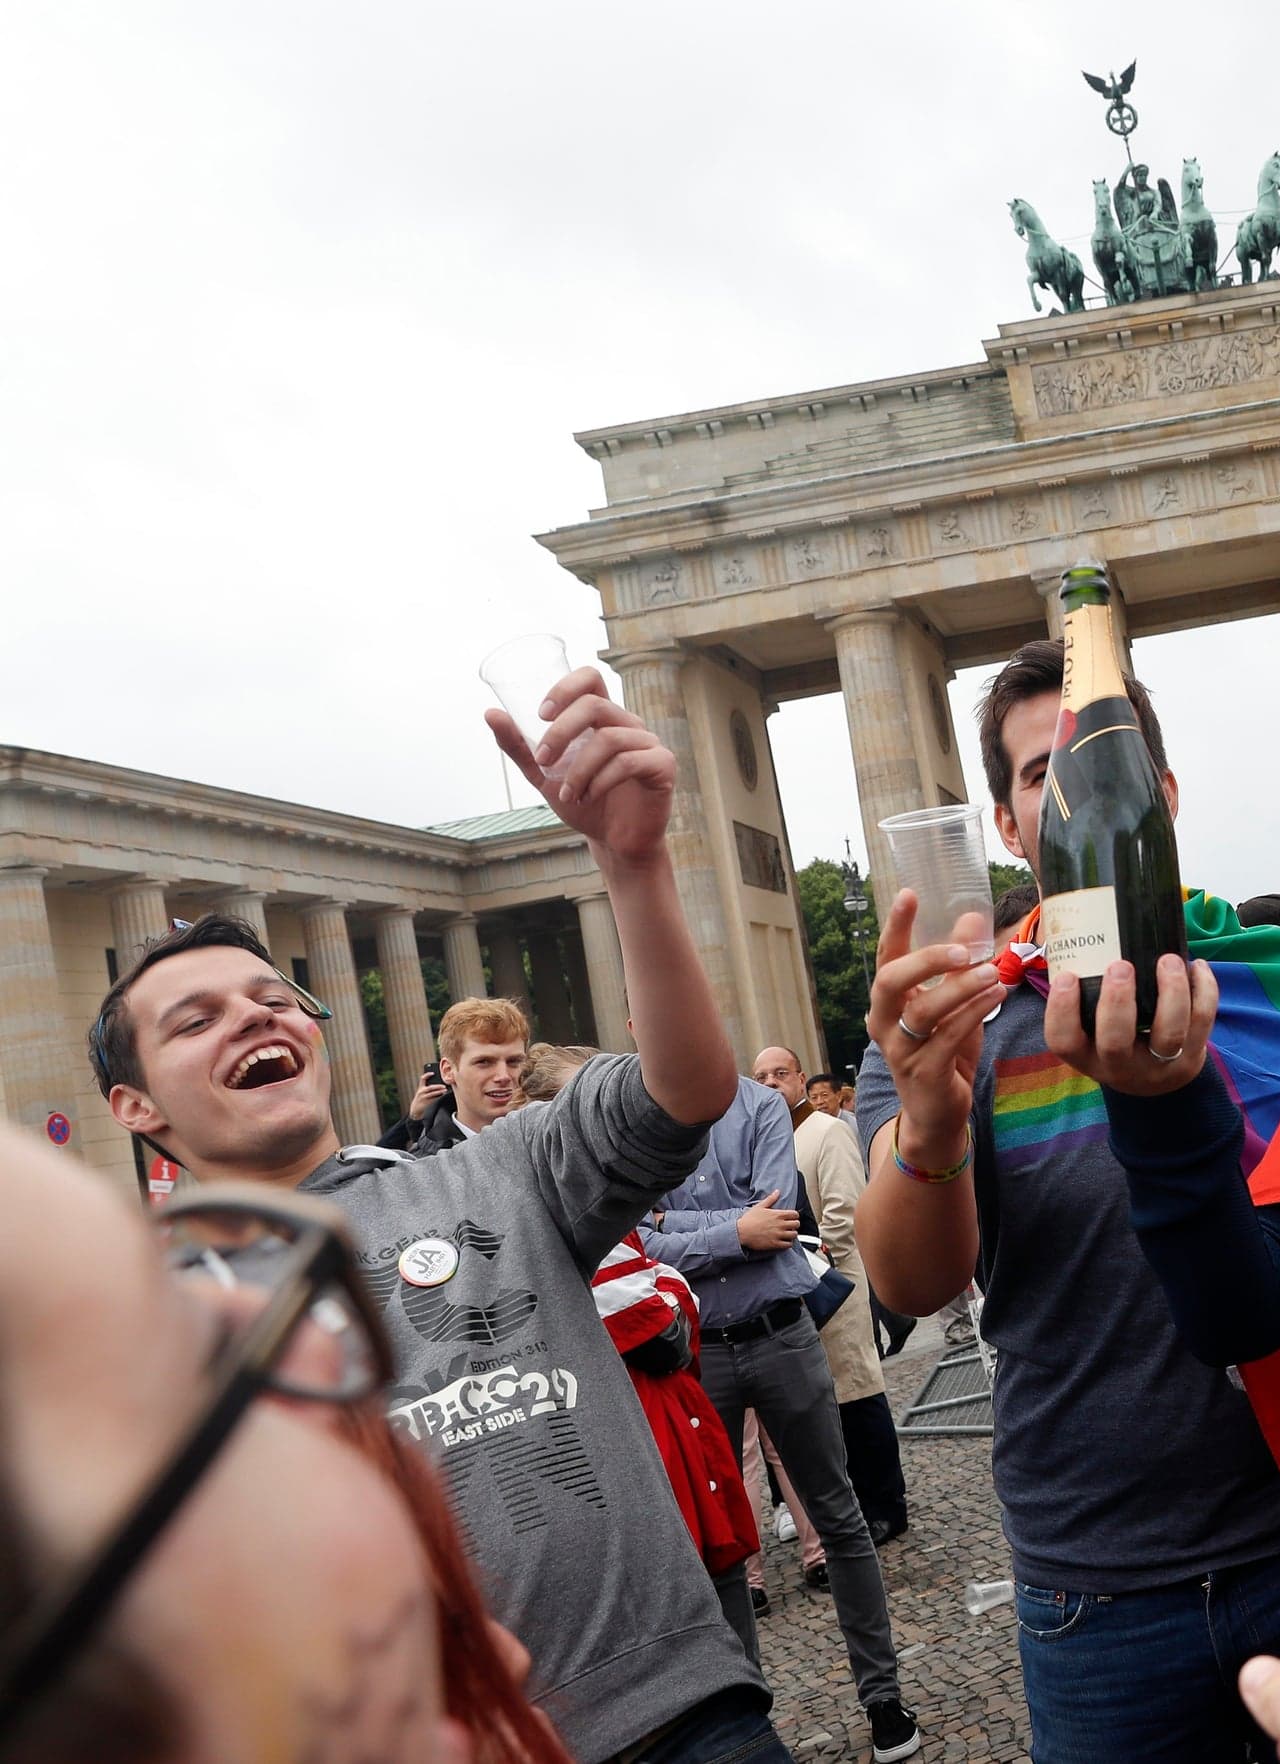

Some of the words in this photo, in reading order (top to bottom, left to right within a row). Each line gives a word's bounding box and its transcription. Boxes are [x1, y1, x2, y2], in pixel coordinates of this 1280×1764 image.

[1052, 933, 1106, 953] CHANDON
[411, 1249, 442, 1275] JA
[470, 1348, 523, 1374] EDITION
[441, 1420, 485, 1447] EAST
[485, 1407, 527, 1432] SIDE
